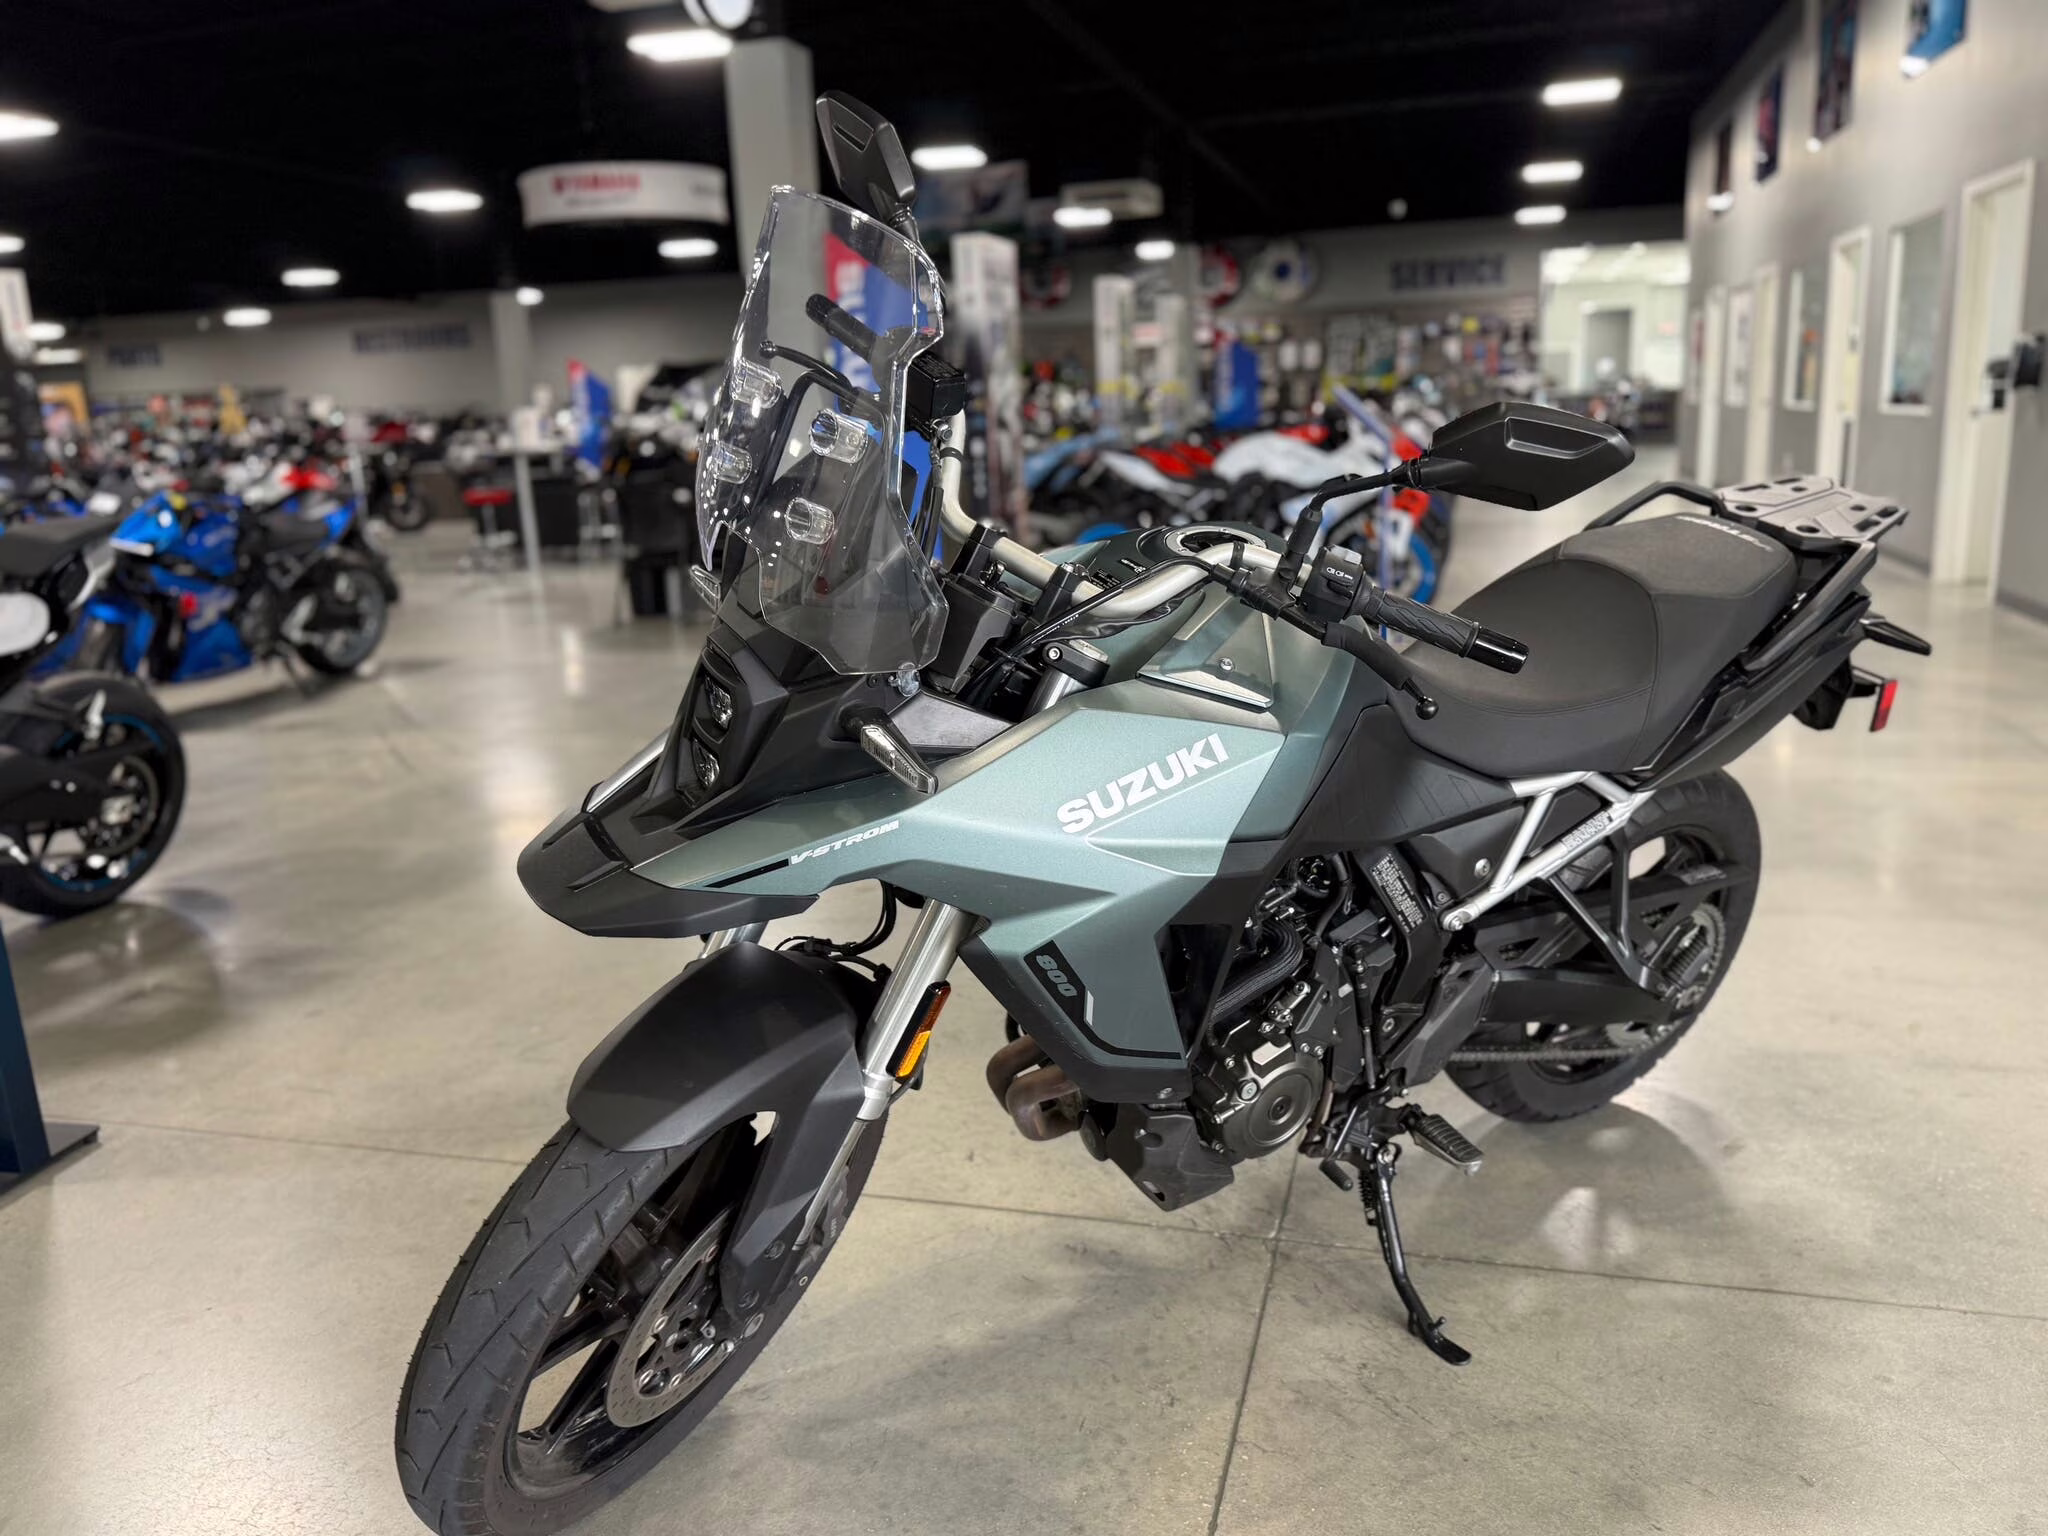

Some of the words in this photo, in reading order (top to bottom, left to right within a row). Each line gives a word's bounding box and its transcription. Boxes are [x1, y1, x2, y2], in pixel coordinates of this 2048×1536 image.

[1057, 733, 1229, 834] SUZUKI
[791, 820, 899, 865] V-STROM
[1036, 955, 1078, 997] 800
